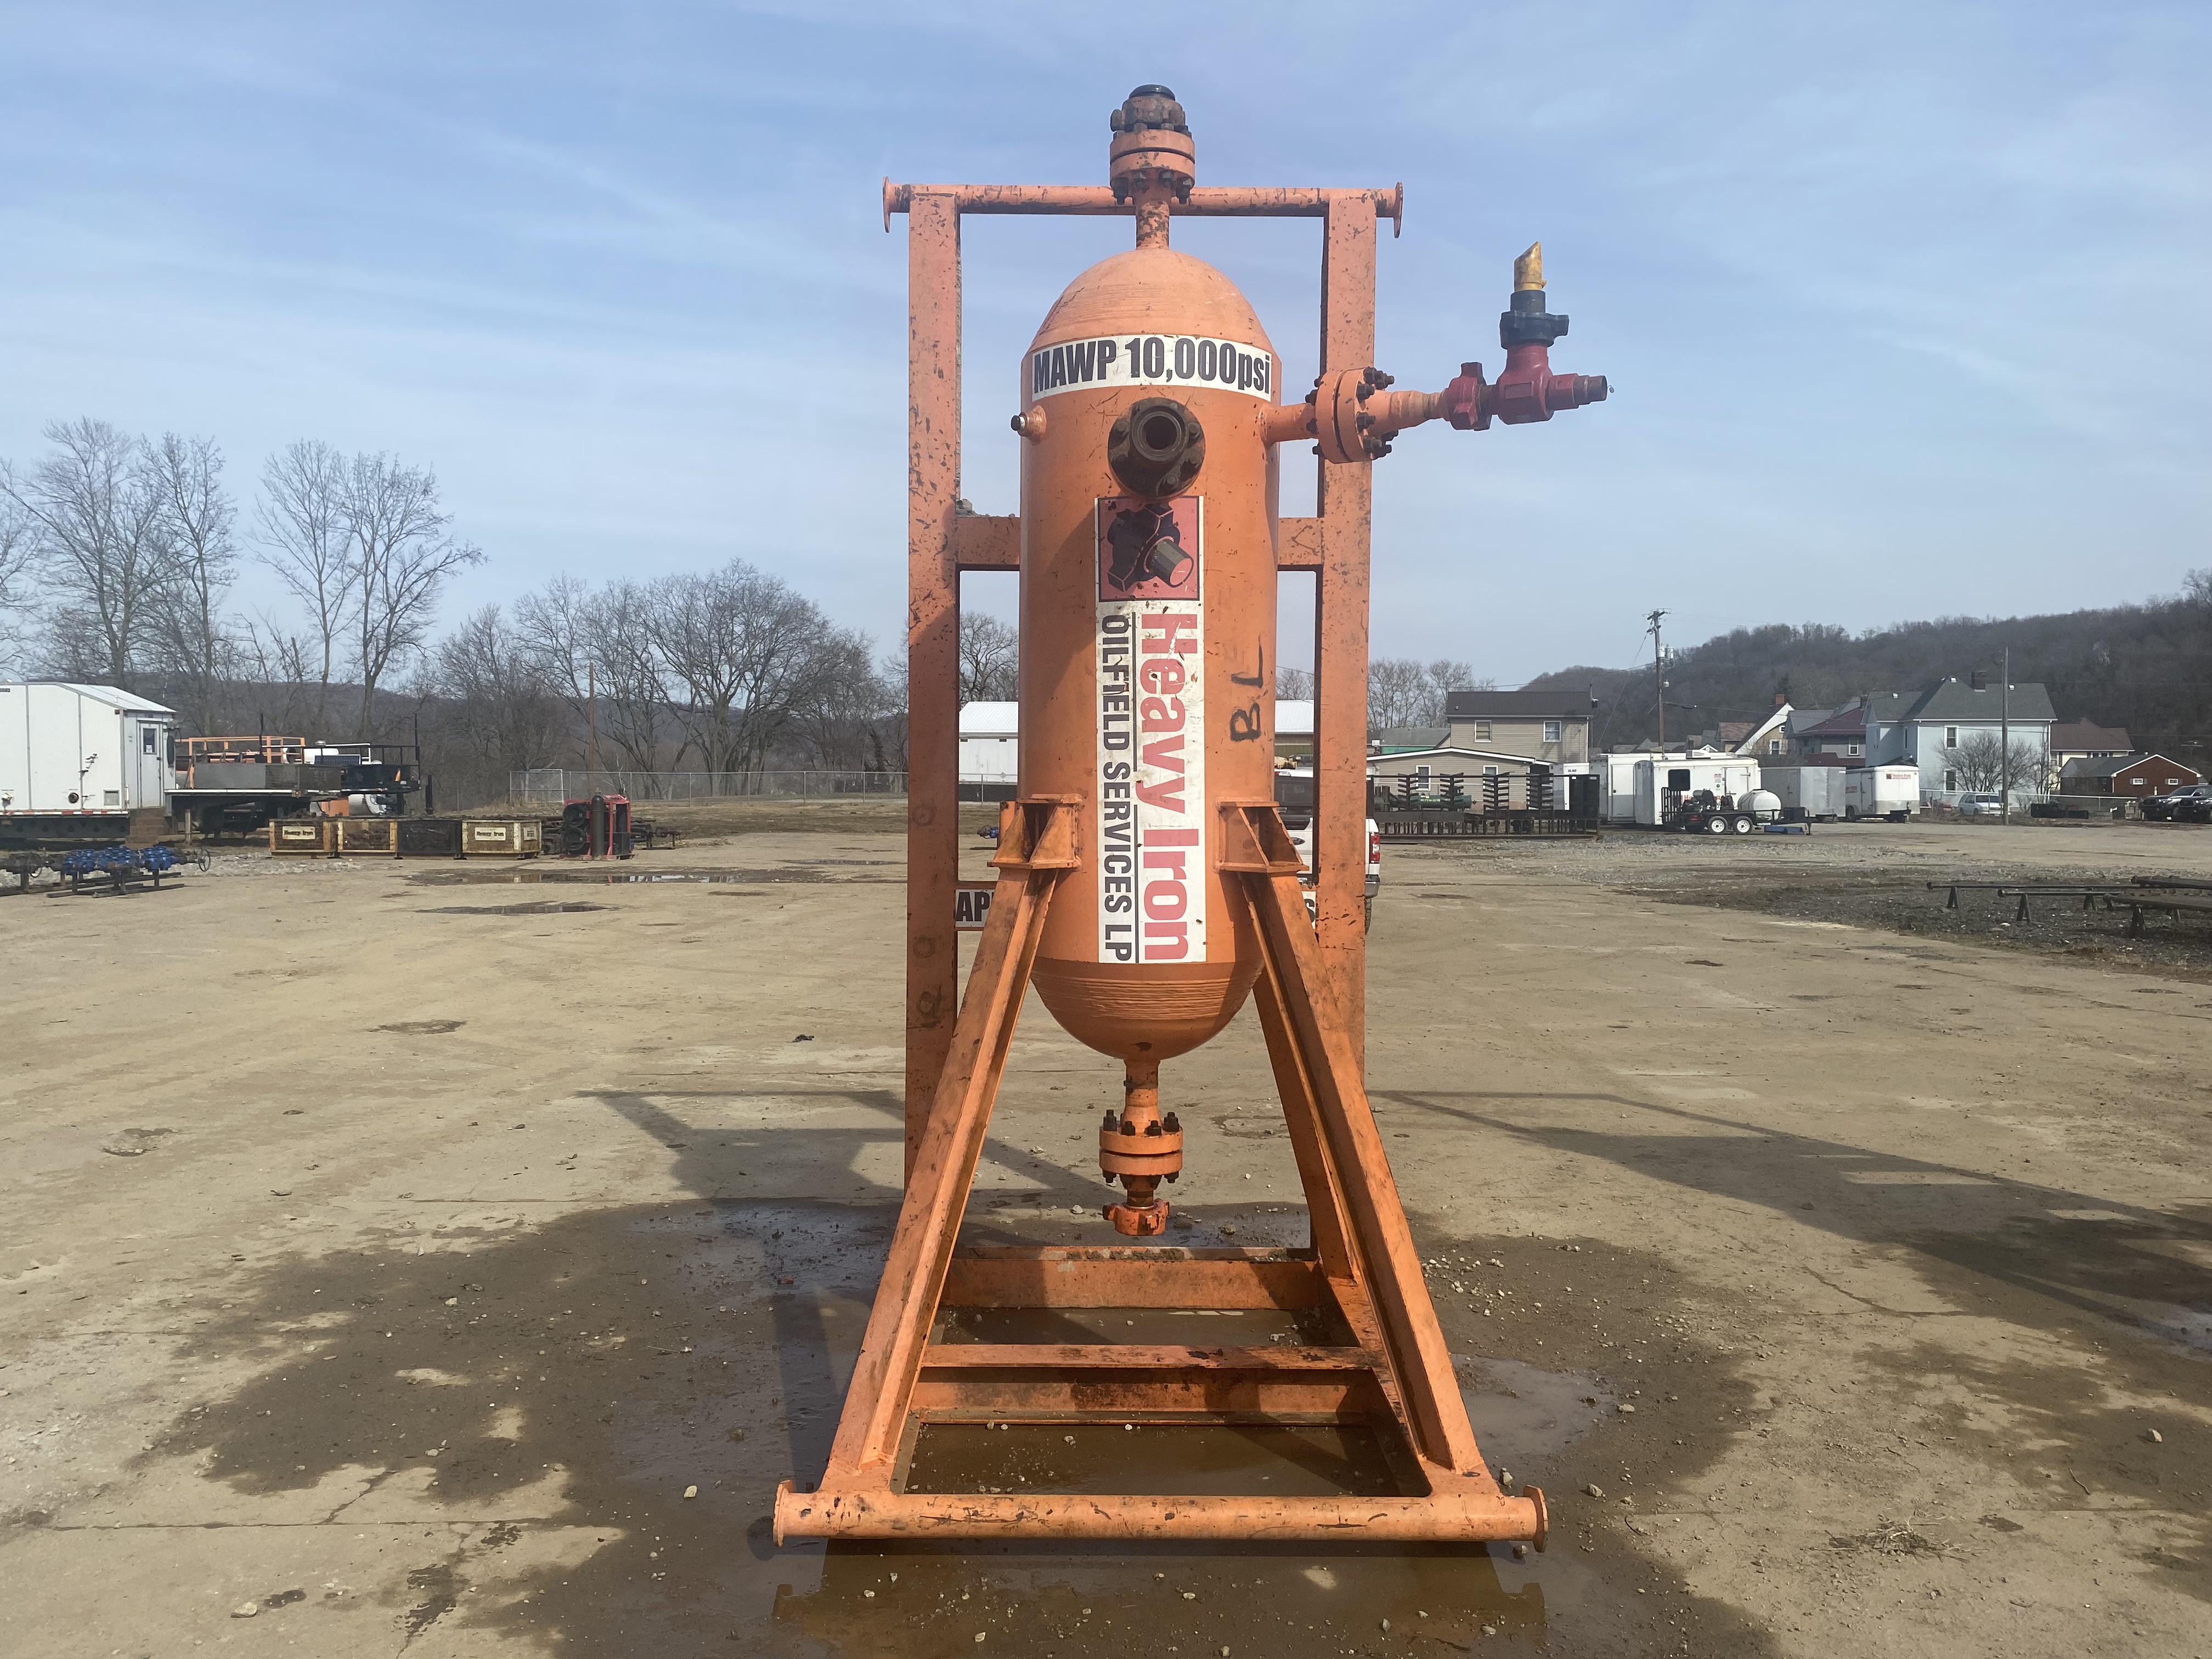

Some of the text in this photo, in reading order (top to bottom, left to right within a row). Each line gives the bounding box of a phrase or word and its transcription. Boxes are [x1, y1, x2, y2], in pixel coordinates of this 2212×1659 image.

[1034, 337, 1270, 394] MAWP 10,000psi
[1102, 615, 1132, 961] OILFIELD SERVICES LP
[1136, 614, 1199, 960] Heavy Iron
